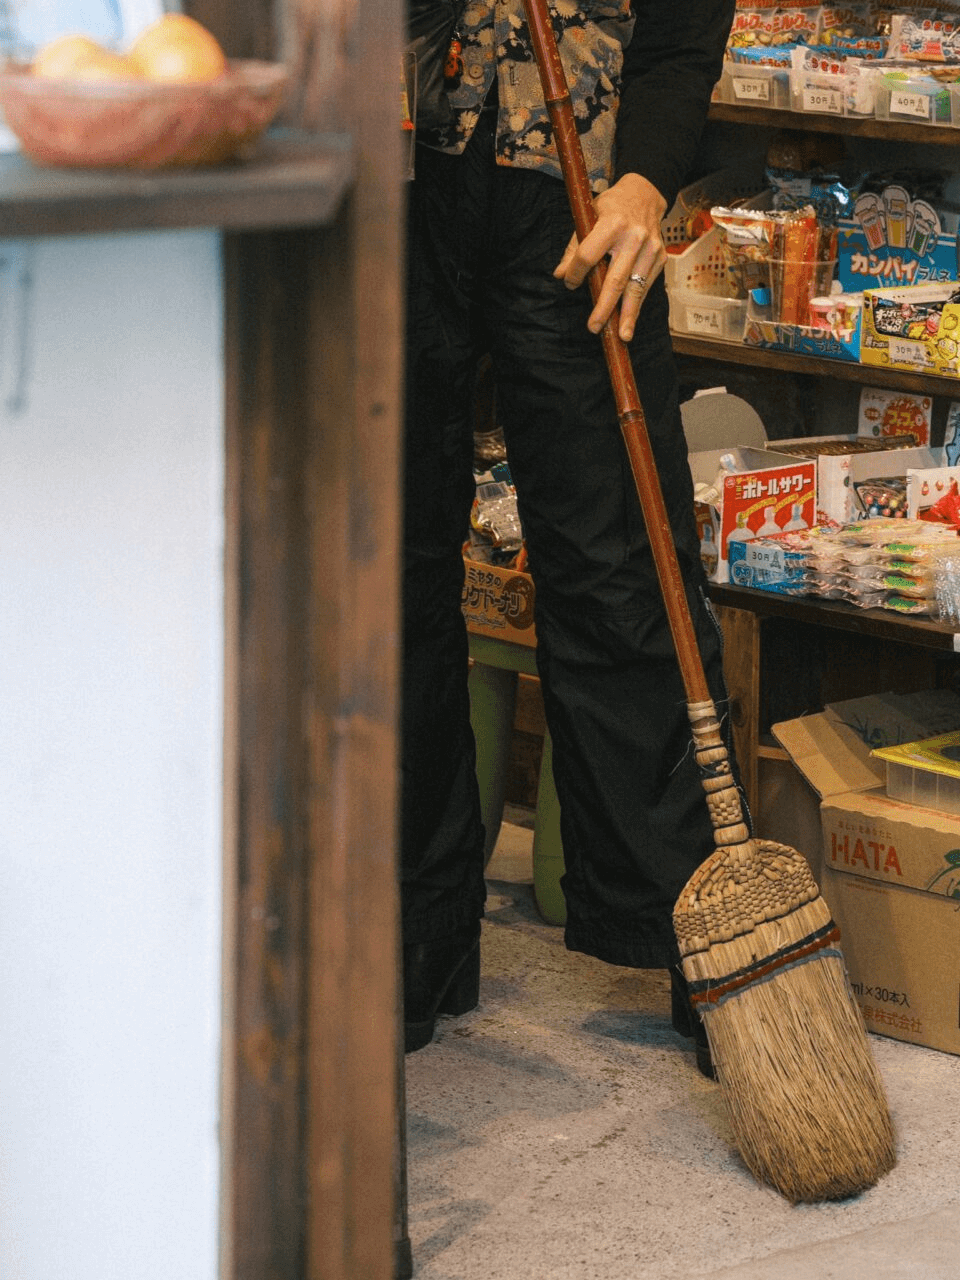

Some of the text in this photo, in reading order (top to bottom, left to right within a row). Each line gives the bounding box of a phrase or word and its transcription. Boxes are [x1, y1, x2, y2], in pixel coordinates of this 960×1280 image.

[741, 83, 758, 92] 30円
[810, 95, 828, 105] 30円
[897, 97, 915, 107] 40円
[850, 252, 919, 282] カンパイ
[918, 266, 952, 282] ラムネ
[742, 473, 812, 500] ボトルサワー
[752, 551, 770, 562] 30円
[467, 566, 502, 588] ミヤタの
[831, 831, 904, 878] HATA
[861, 1004, 923, 1034] 泉株式会社
